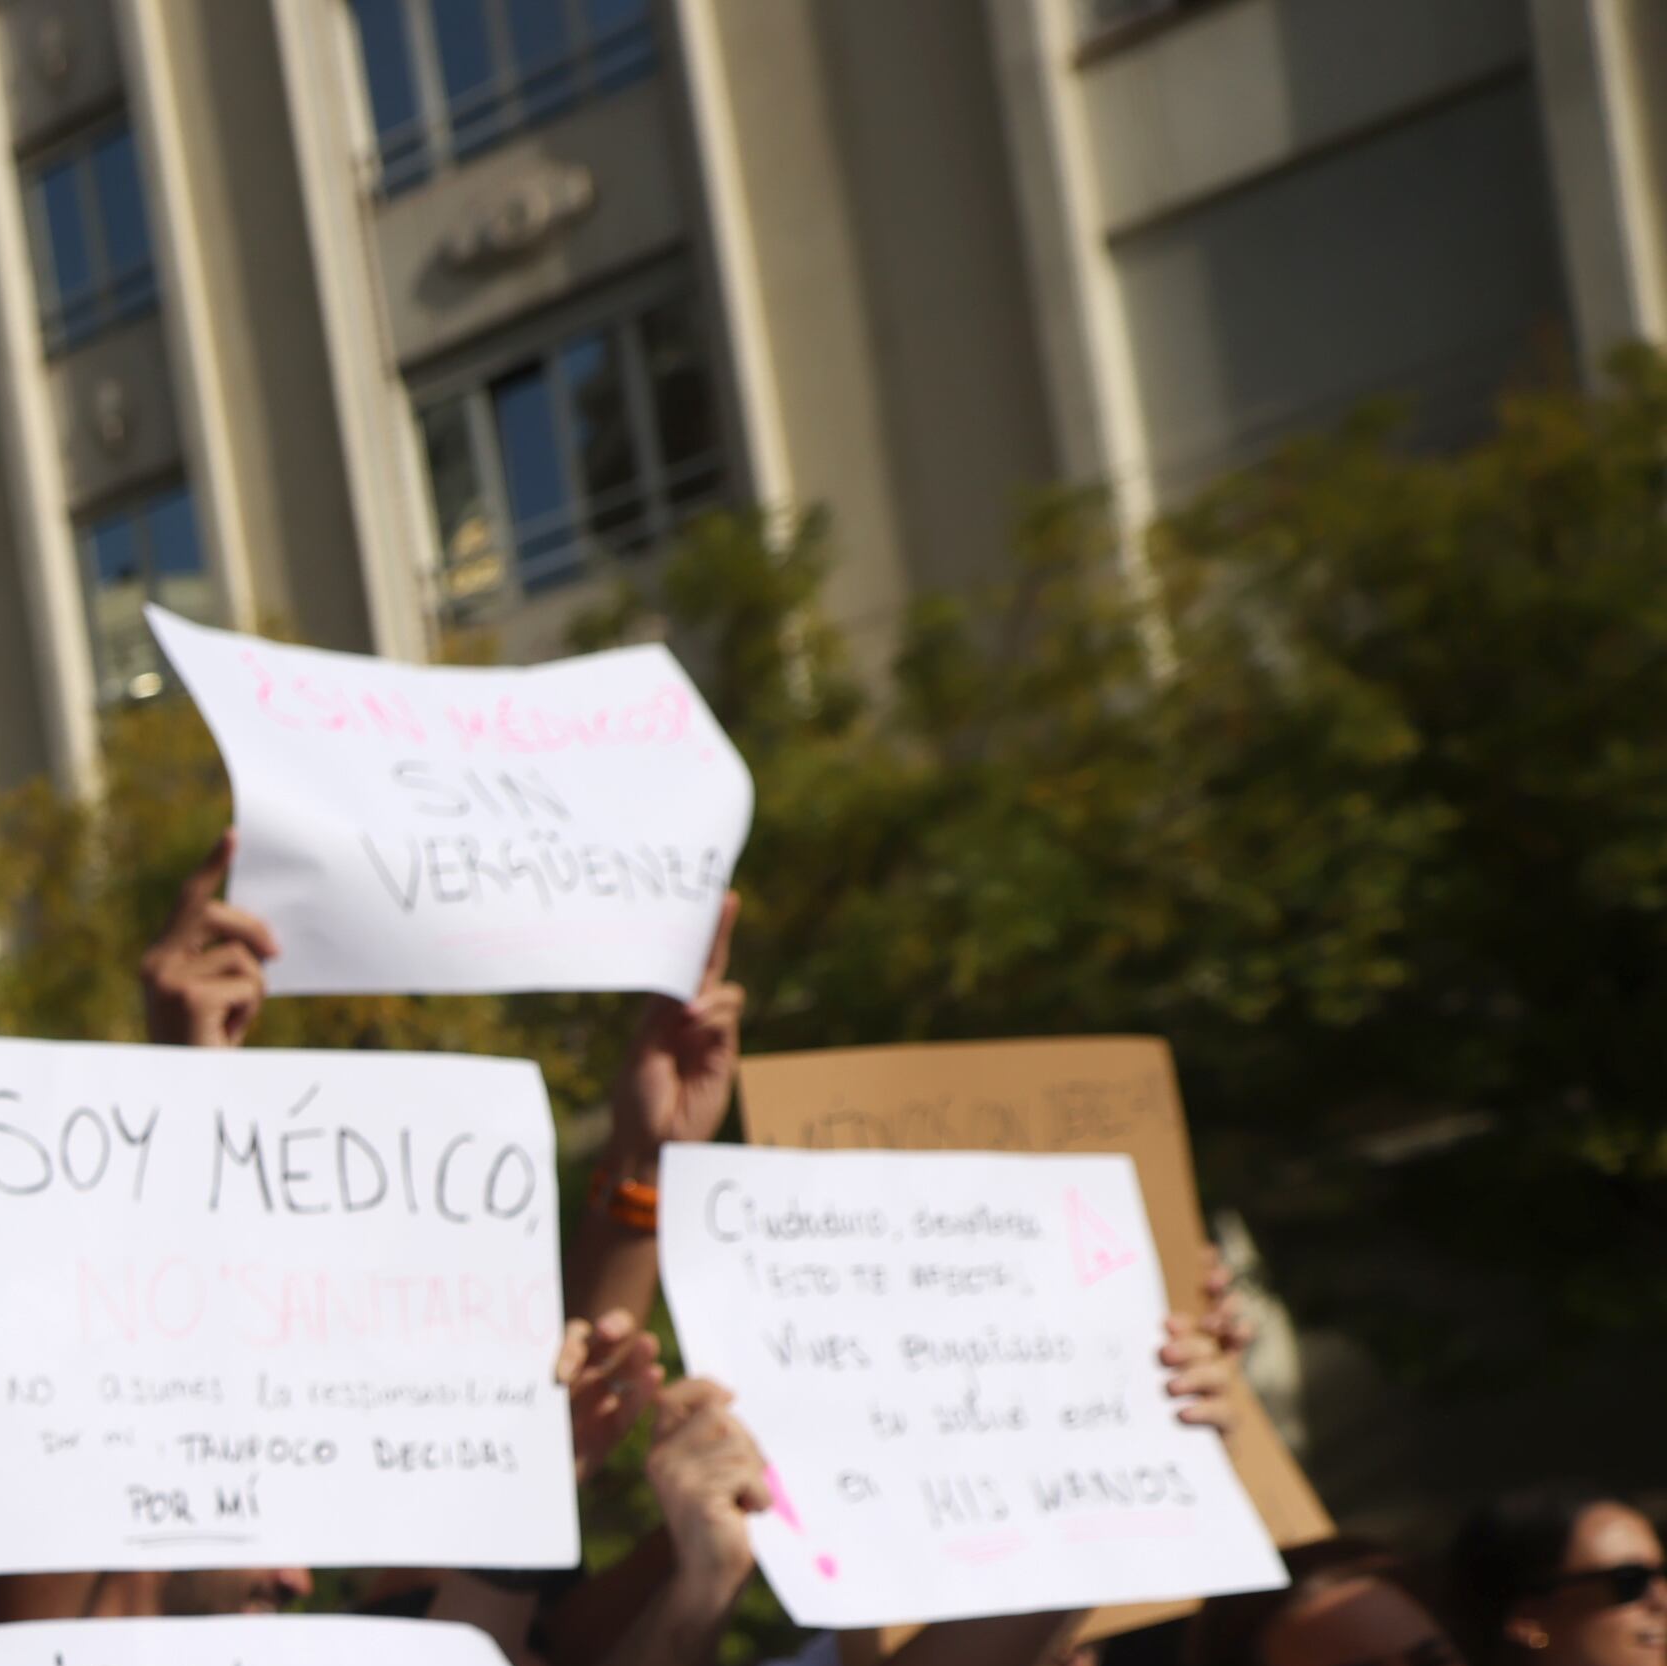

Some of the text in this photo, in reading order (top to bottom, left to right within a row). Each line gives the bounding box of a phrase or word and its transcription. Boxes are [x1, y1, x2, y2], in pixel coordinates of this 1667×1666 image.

[392, 760, 571, 821] SIN
[208, 1084, 539, 1237] MÉDICO,
[74, 1255, 206, 1342] NO
[97, 1375, 226, 1405] asumes
[256, 1370, 293, 1410] la
[370, 1434, 520, 1473] DECIDAS
[123, 1482, 197, 1525] POR
